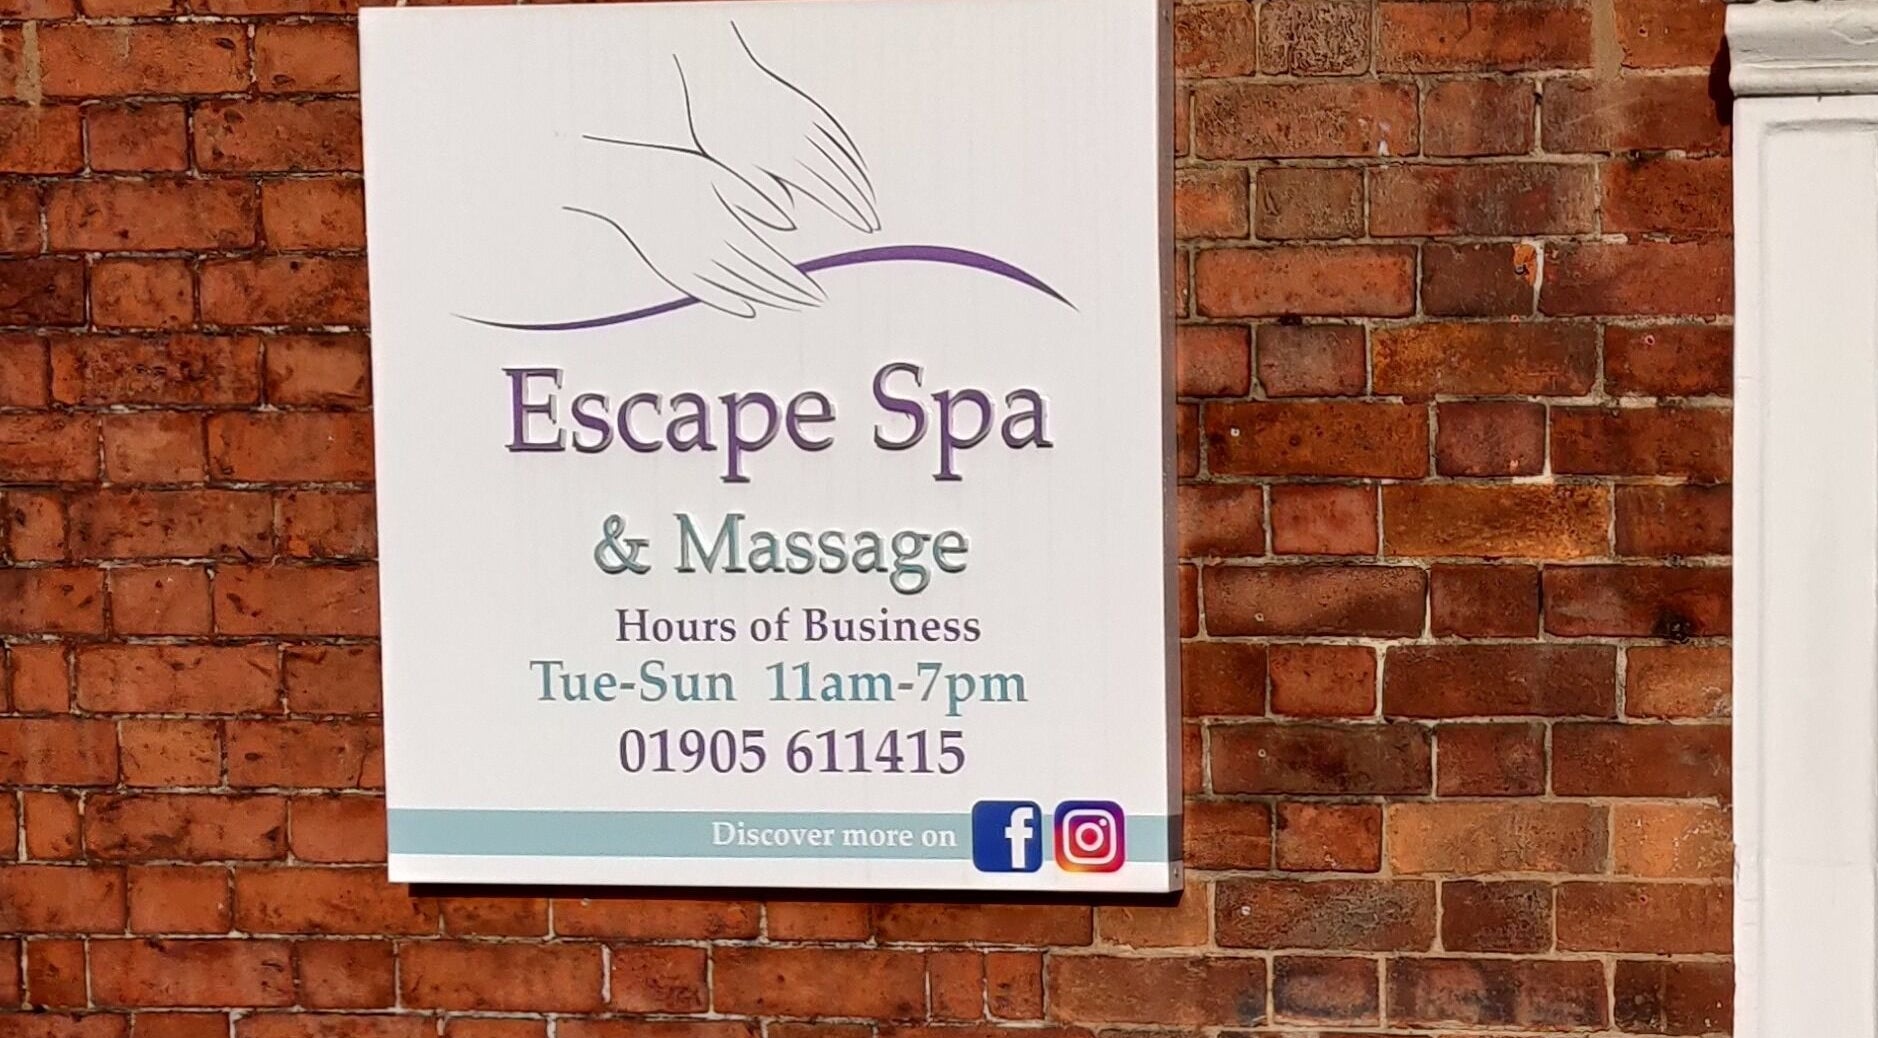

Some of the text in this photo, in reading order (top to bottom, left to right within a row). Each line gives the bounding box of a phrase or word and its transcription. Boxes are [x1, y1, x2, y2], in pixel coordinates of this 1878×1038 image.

[502, 361, 1054, 483] Escape Spa
[592, 511, 970, 595] & Massage
[615, 607, 982, 644] Hours of Business
[529, 659, 1028, 717] Tue-Sun 11am-7pm
[618, 728, 968, 775] 01905 611415
[711, 821, 957, 849] Discover more on
